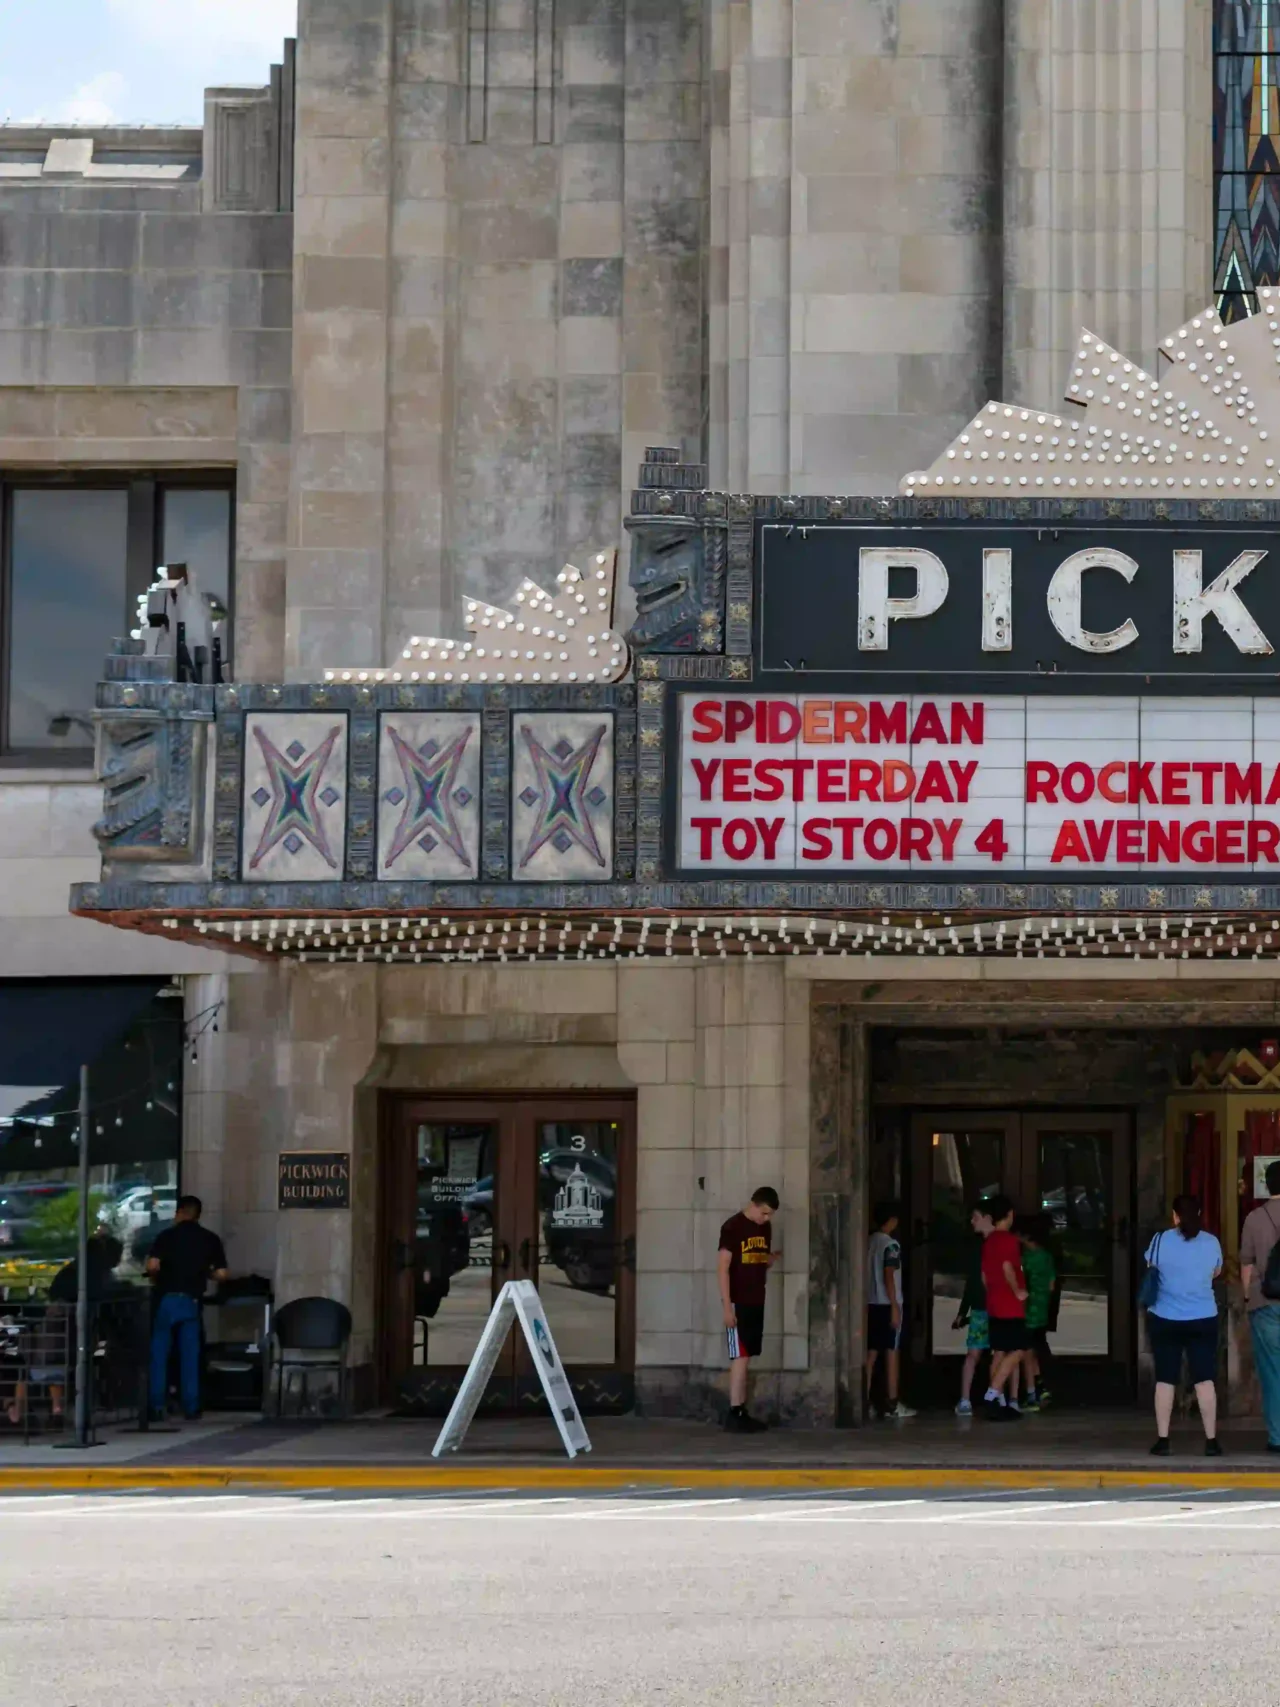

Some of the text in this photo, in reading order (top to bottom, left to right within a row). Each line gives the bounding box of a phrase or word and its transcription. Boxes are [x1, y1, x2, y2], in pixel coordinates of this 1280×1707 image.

[692, 700, 984, 744] SPIDERMAN
[690, 758, 979, 803] YESTERDAY
[690, 817, 1008, 862] TOY STORY 4
[571, 1135, 587, 1152] 3
[280, 1164, 348, 1179] PICKWICK
[431, 1176, 478, 1184] PICKWICK
[283, 1185, 344, 1198] BUILDING
